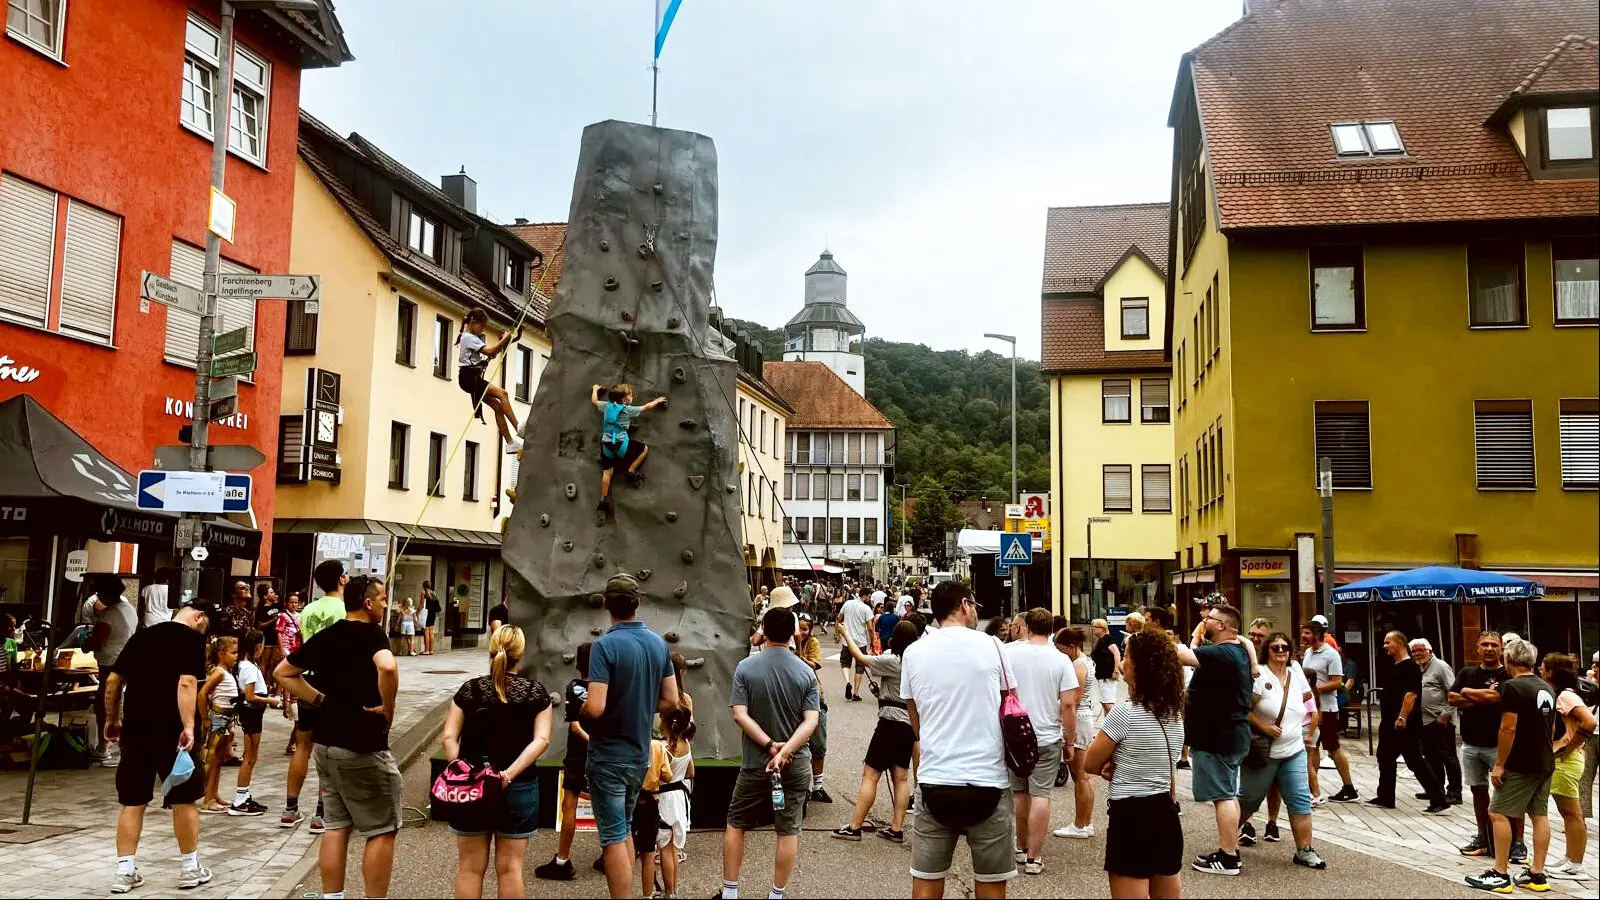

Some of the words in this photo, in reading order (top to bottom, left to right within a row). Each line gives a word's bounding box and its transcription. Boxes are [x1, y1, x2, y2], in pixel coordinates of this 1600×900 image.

[222, 277, 272, 286] Forchtenberg
[221, 287, 263, 296] Ingelfingen
[165, 397, 247, 429] KONREI
[312, 468, 335, 479] SCHMUCK
[120, 517, 163, 534] XLMOTO
[212, 531, 246, 547] XLMOTO
[1242, 559, 1283, 573] Sperber
[1392, 589, 1445, 598] RIEDBACHER
[1471, 587, 1504, 595] FRANKEN
